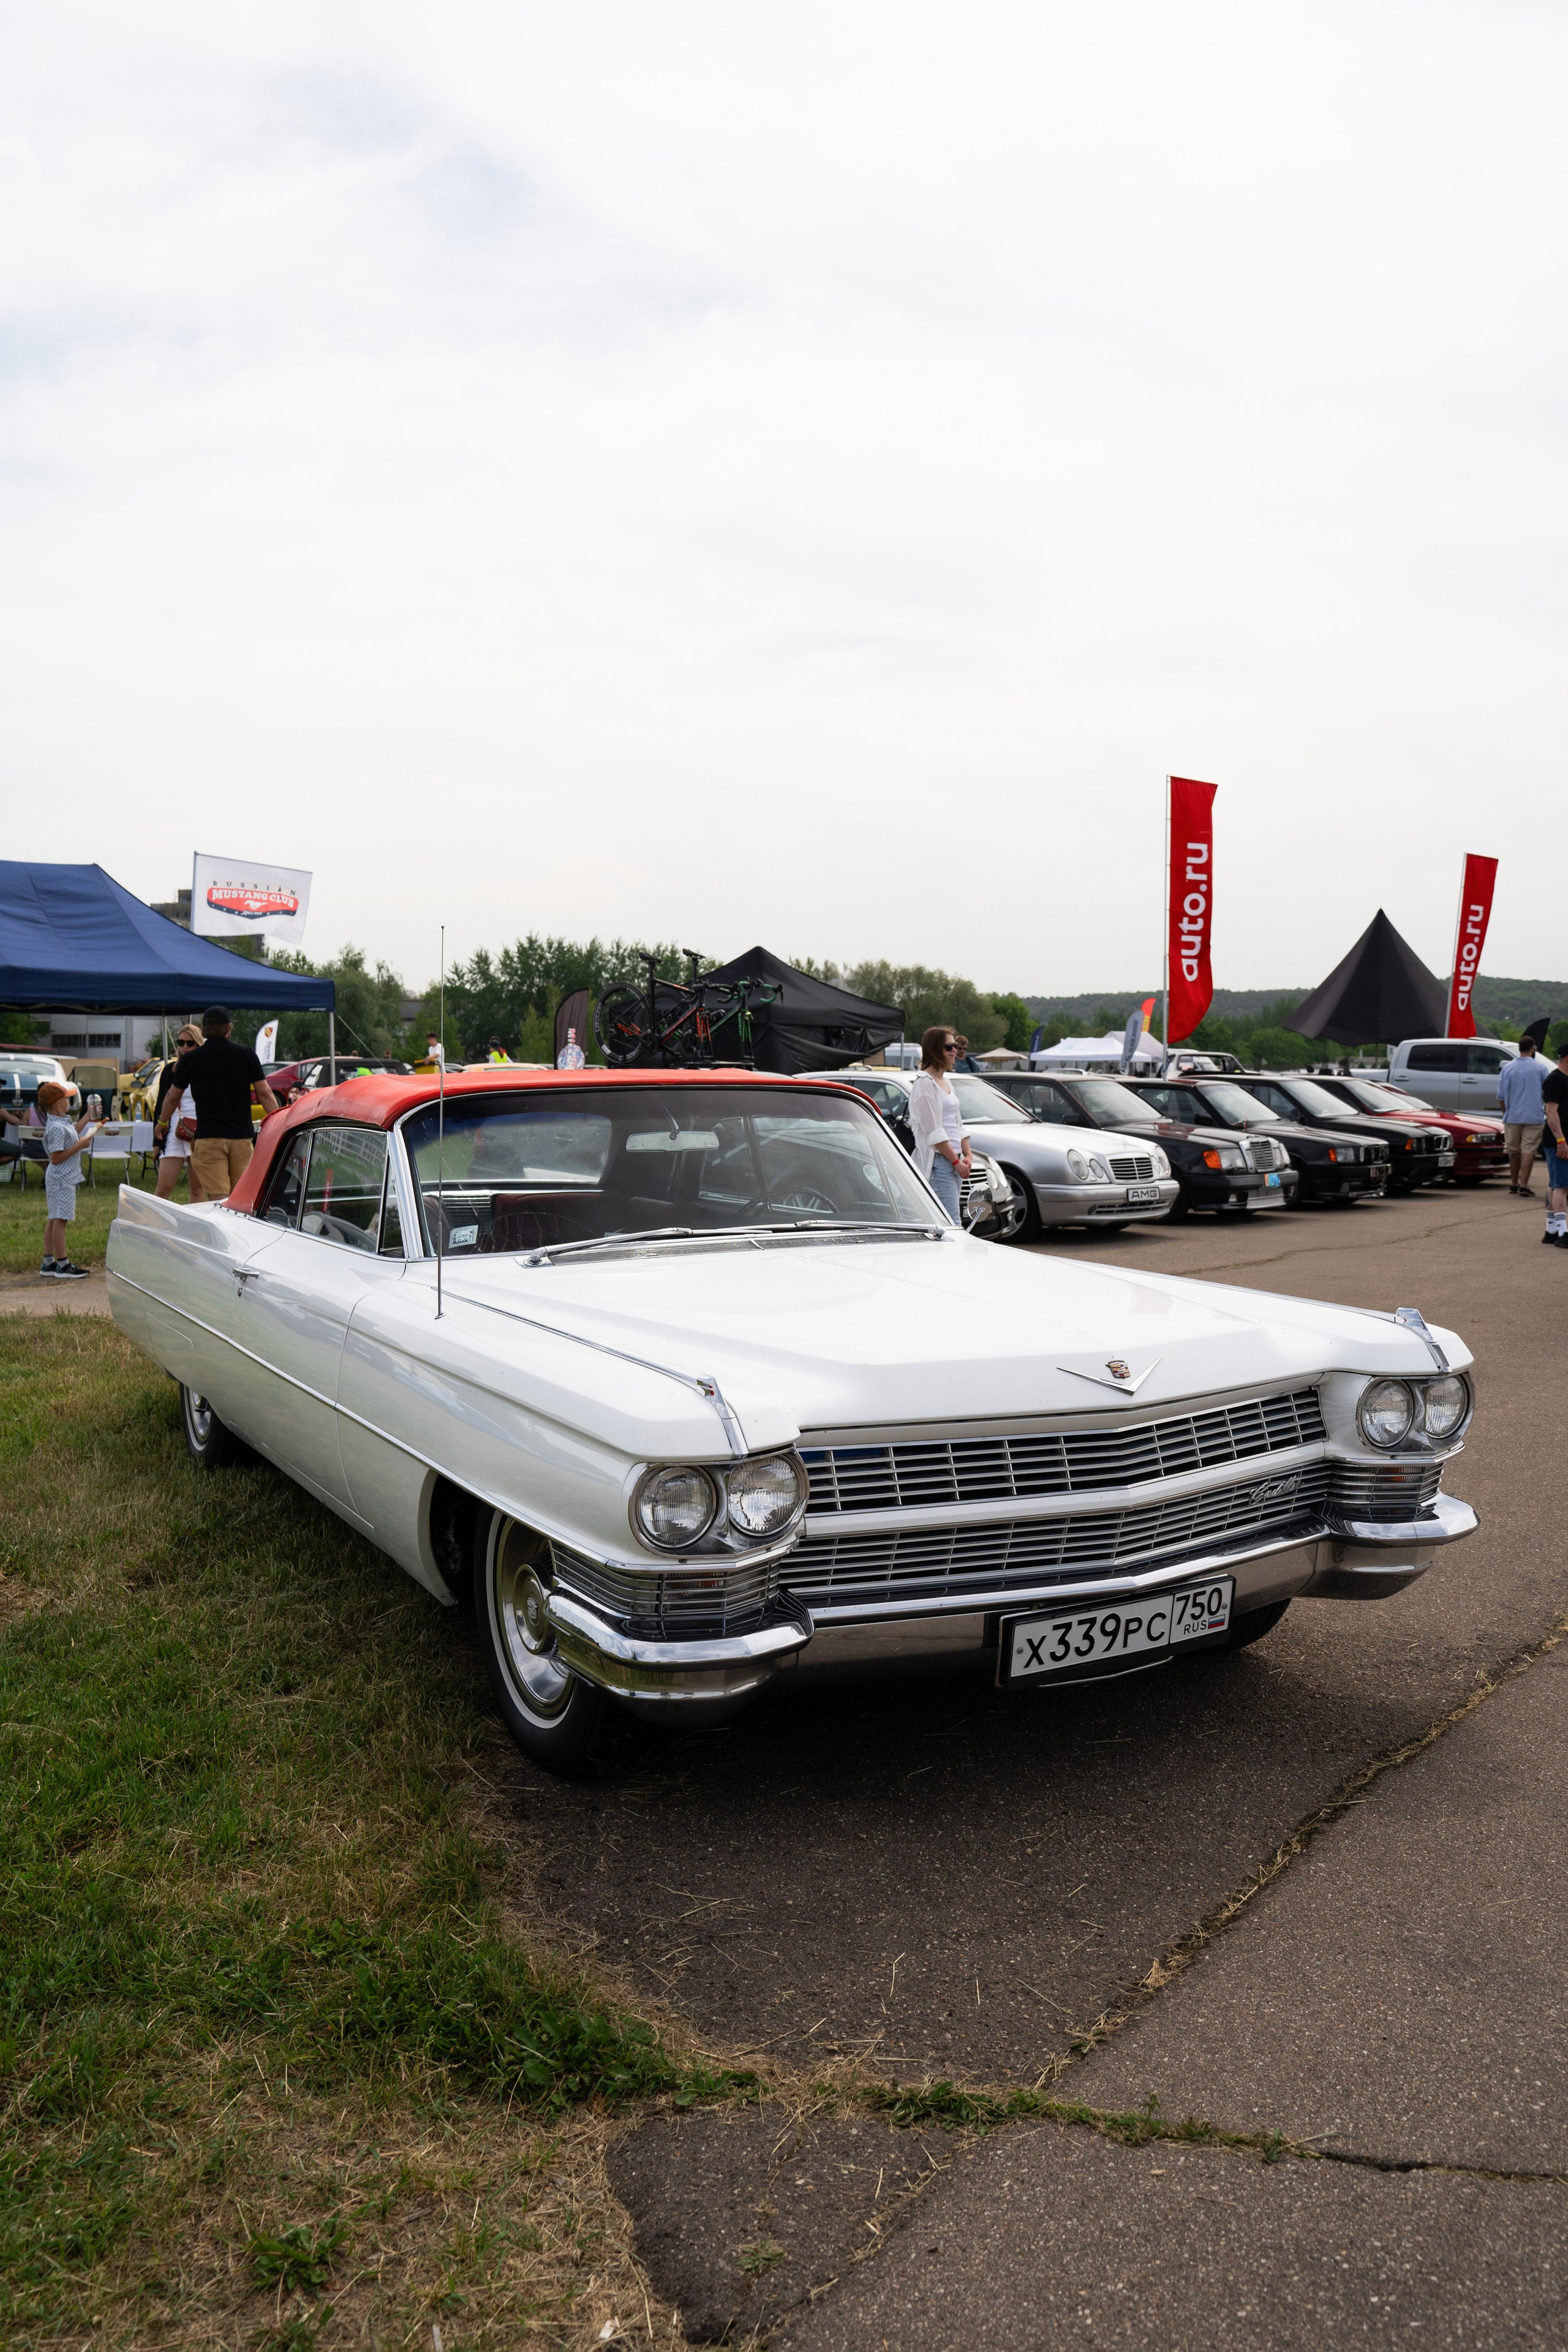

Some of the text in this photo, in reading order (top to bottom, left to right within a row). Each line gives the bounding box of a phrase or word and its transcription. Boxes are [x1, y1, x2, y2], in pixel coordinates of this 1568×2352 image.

[213, 881, 296, 895] RUSSIAN
[211, 889, 295, 908] MUSTANG CLUB
[1178, 842, 1208, 982] auto.ru
[1458, 904, 1484, 1011] auto.ru
[1131, 1190, 1157, 1199] AMG
[1175, 1587, 1223, 1625] 750
[1183, 1619, 1207, 1635] RUS
